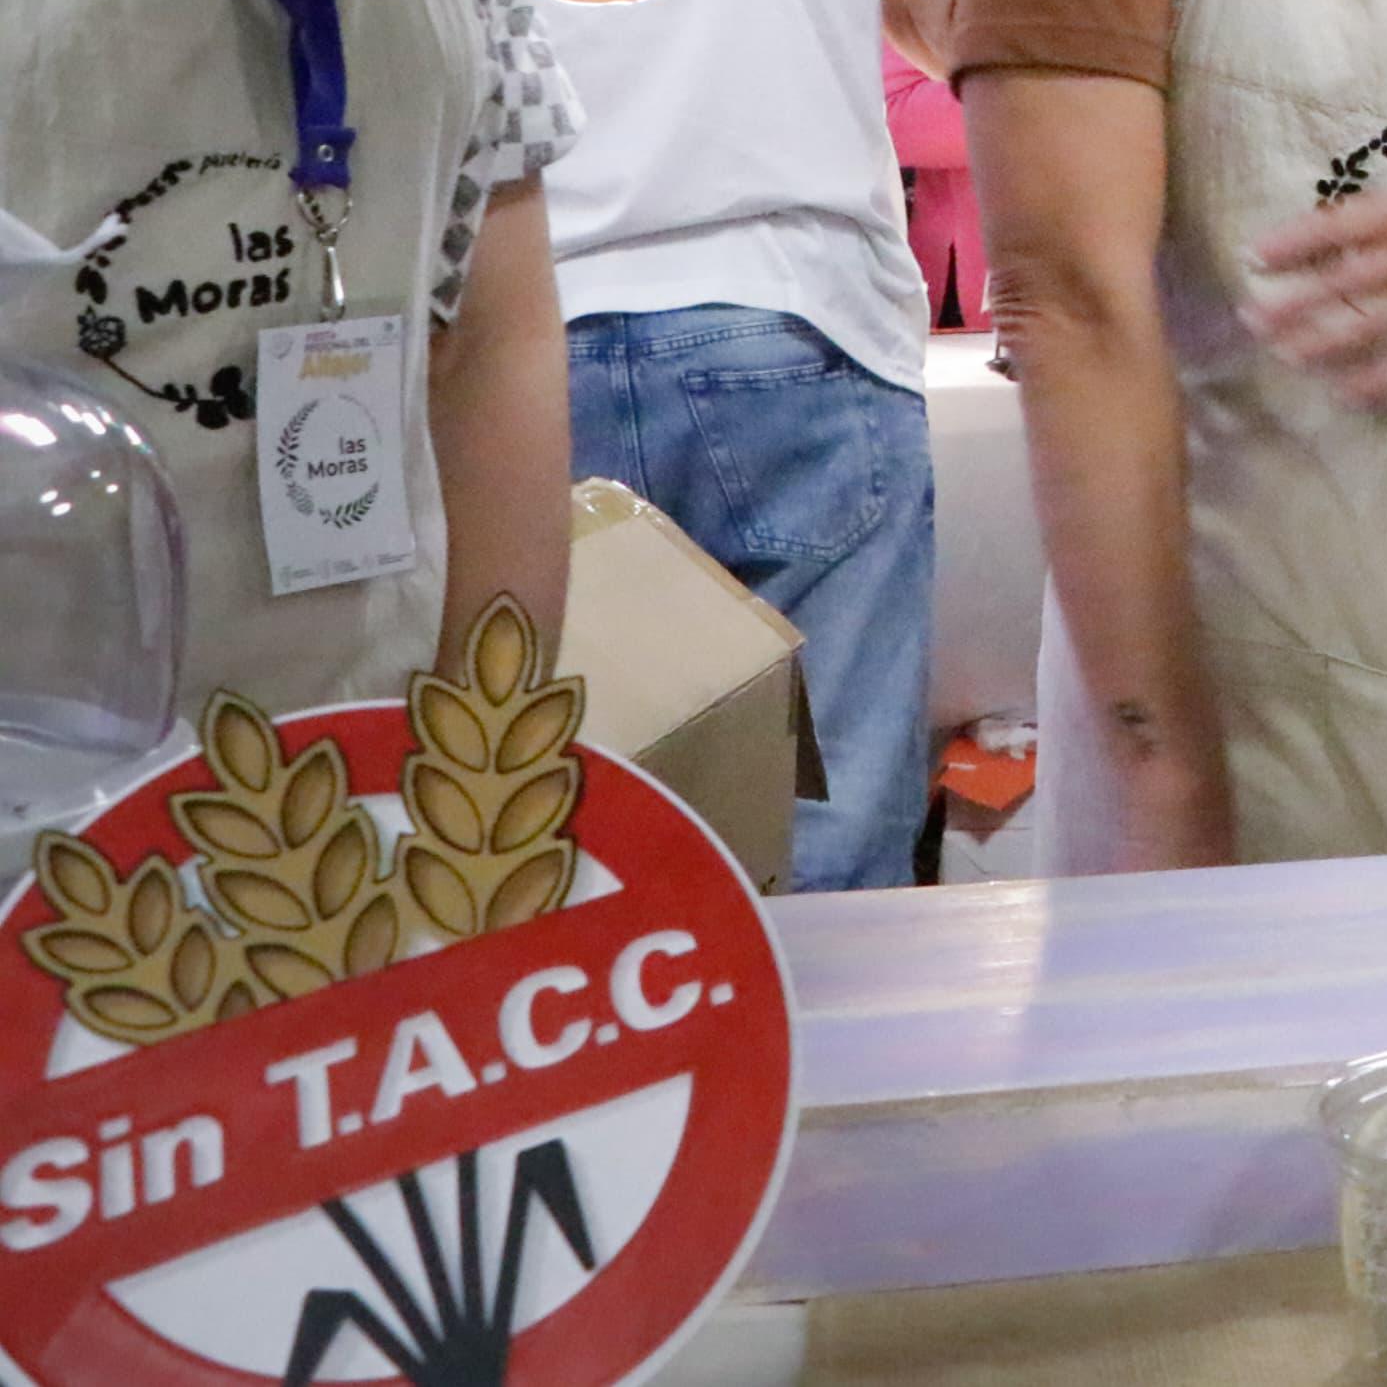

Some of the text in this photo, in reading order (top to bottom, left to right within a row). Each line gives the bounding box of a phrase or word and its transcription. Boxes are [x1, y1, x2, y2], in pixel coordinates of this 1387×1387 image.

[228, 222, 295, 263] las
[135, 267, 291, 324] Moras
[338, 436, 367, 455] las
[307, 458, 368, 479] Moras
[0, 928, 736, 1253] Sin T.A.C.C.
